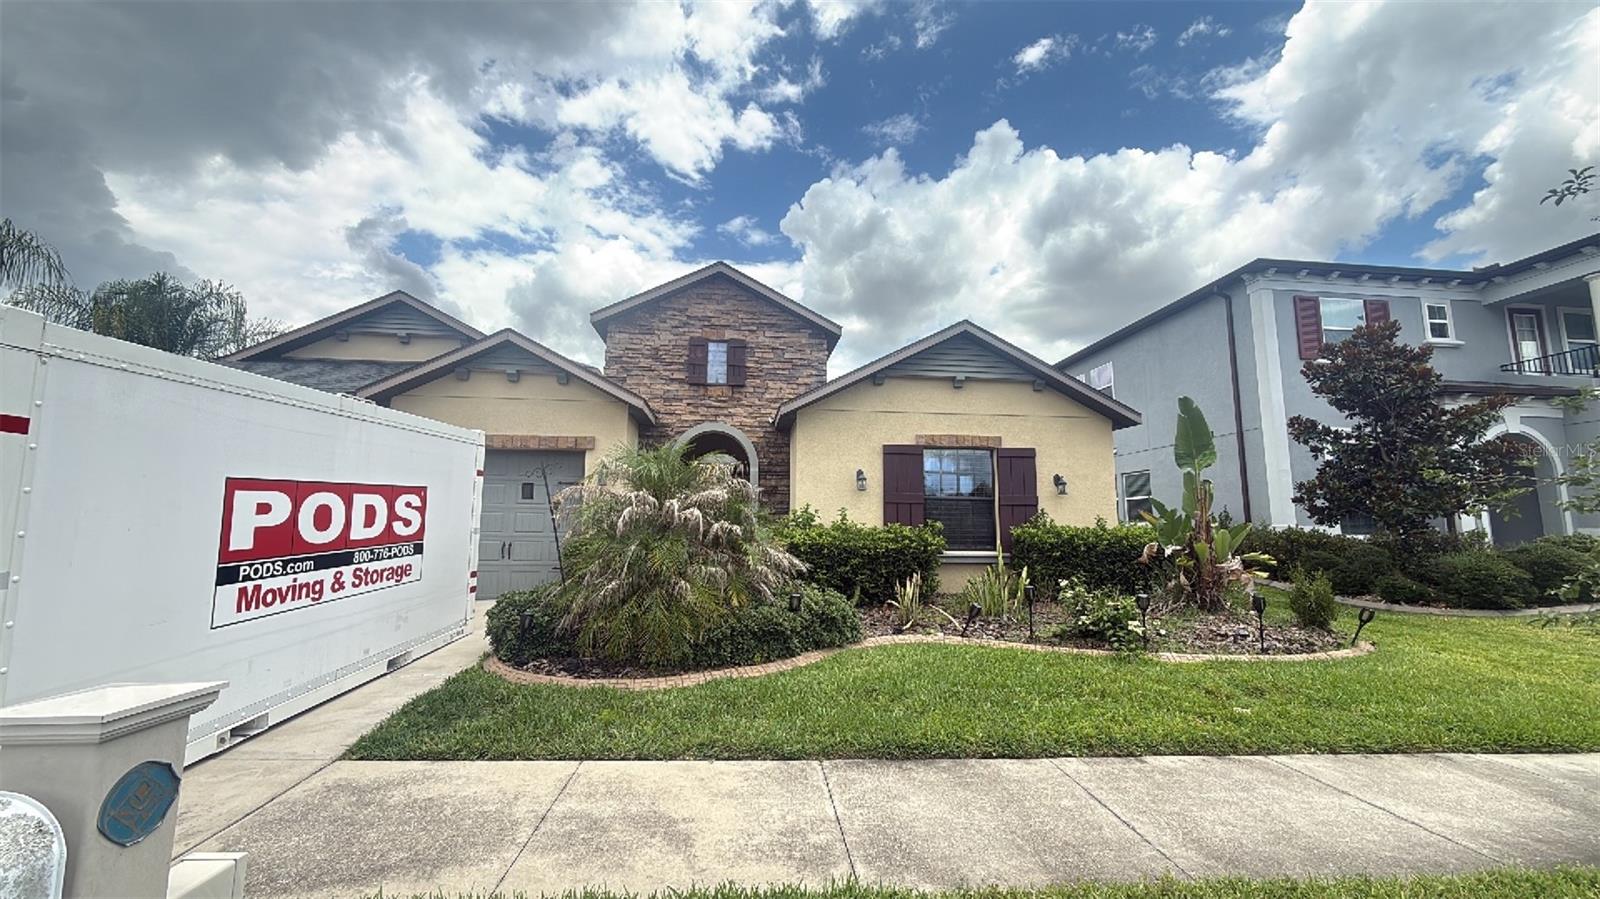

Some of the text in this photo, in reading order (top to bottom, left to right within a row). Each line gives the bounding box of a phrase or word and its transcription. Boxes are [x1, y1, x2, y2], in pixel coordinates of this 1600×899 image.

[229, 490, 422, 551] PODS
[239, 560, 314, 581] PODS.com
[353, 545, 414, 563] 800-776-PODS
[236, 563, 412, 613] Moving & Storage
